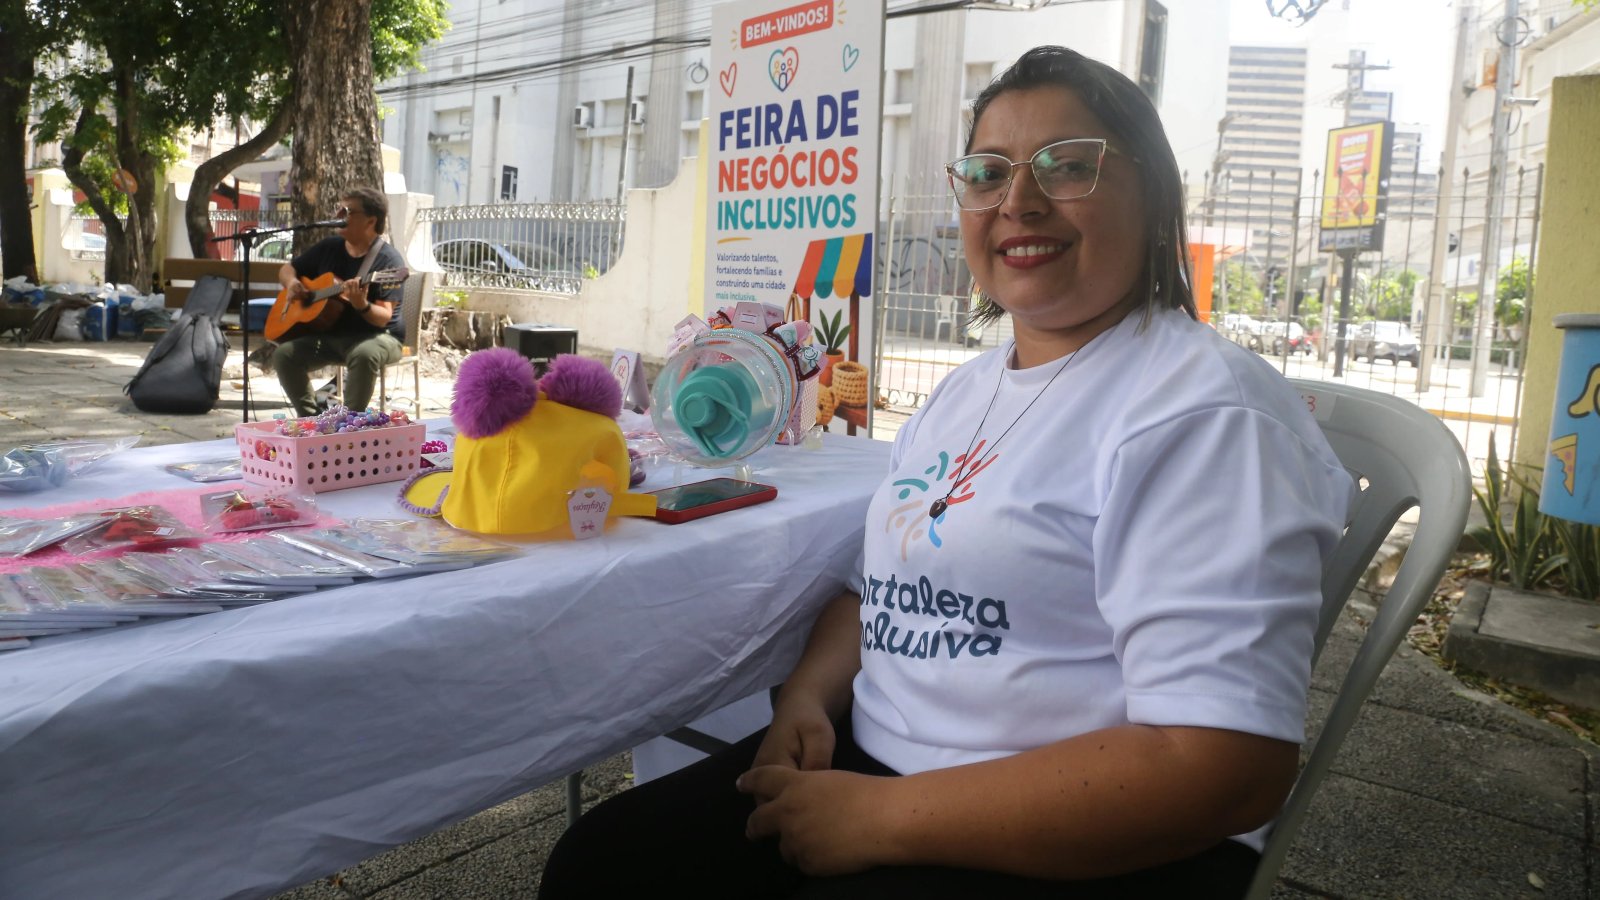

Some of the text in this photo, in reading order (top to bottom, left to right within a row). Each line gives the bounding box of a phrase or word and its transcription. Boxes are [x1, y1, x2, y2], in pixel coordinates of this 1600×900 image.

[745, 5, 828, 42] BEM-VINDOS!
[719, 89, 859, 151] FEIRA DE
[718, 145, 858, 193] NEGÓCIOS
[717, 193, 857, 230] INCLUSIVOS
[716, 265, 752, 275] fortalecendo
[717, 253, 779, 263] Valorizando talentos,
[715, 291, 729, 300] mais
[716, 279, 786, 290] construindo uma cidade
